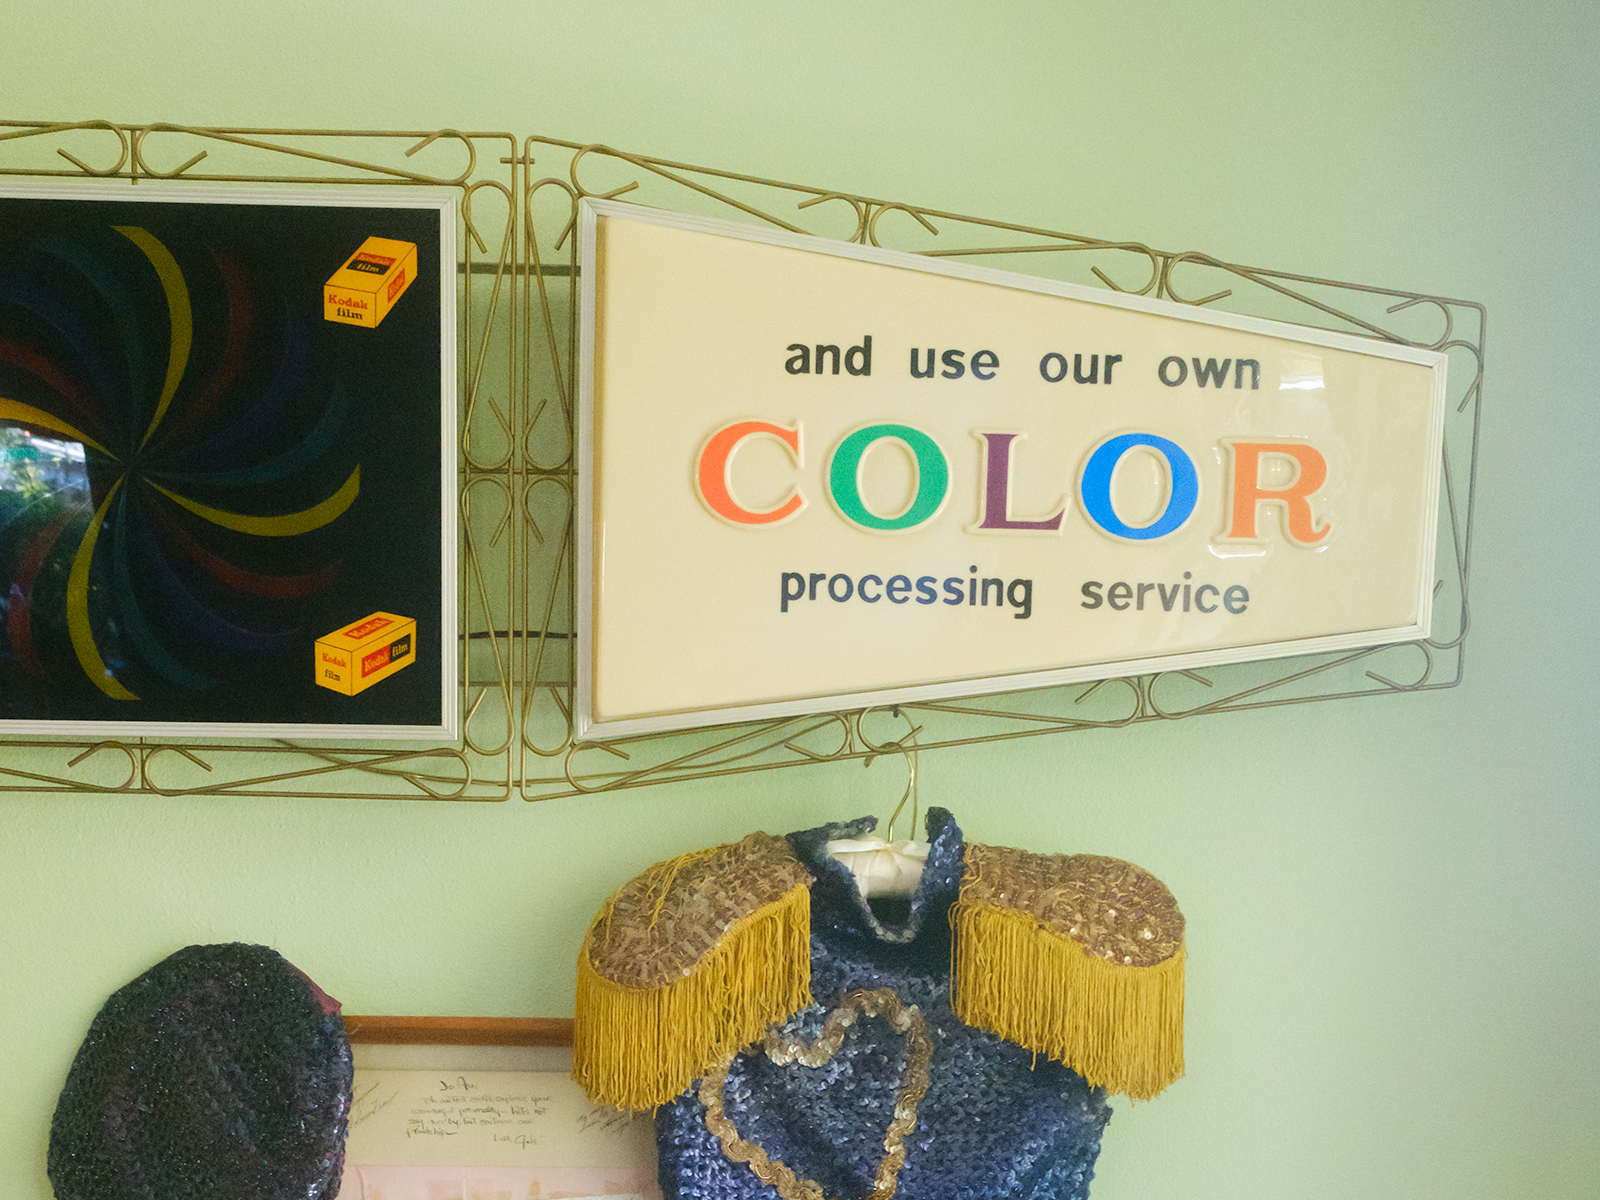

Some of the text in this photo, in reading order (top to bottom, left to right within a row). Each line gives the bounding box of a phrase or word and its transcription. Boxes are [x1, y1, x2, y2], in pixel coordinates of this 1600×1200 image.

[356, 263, 380, 273] film
[328, 294, 368, 310] Kodak
[336, 307, 363, 320] film
[784, 335, 1262, 390] and use our own
[696, 419, 1333, 545] COLOR
[780, 565, 1250, 619] processing service
[348, 619, 391, 638] Kodak
[322, 652, 347, 668] Kodak
[363, 643, 409, 673] Kodak film
[324, 668, 341, 682] film
